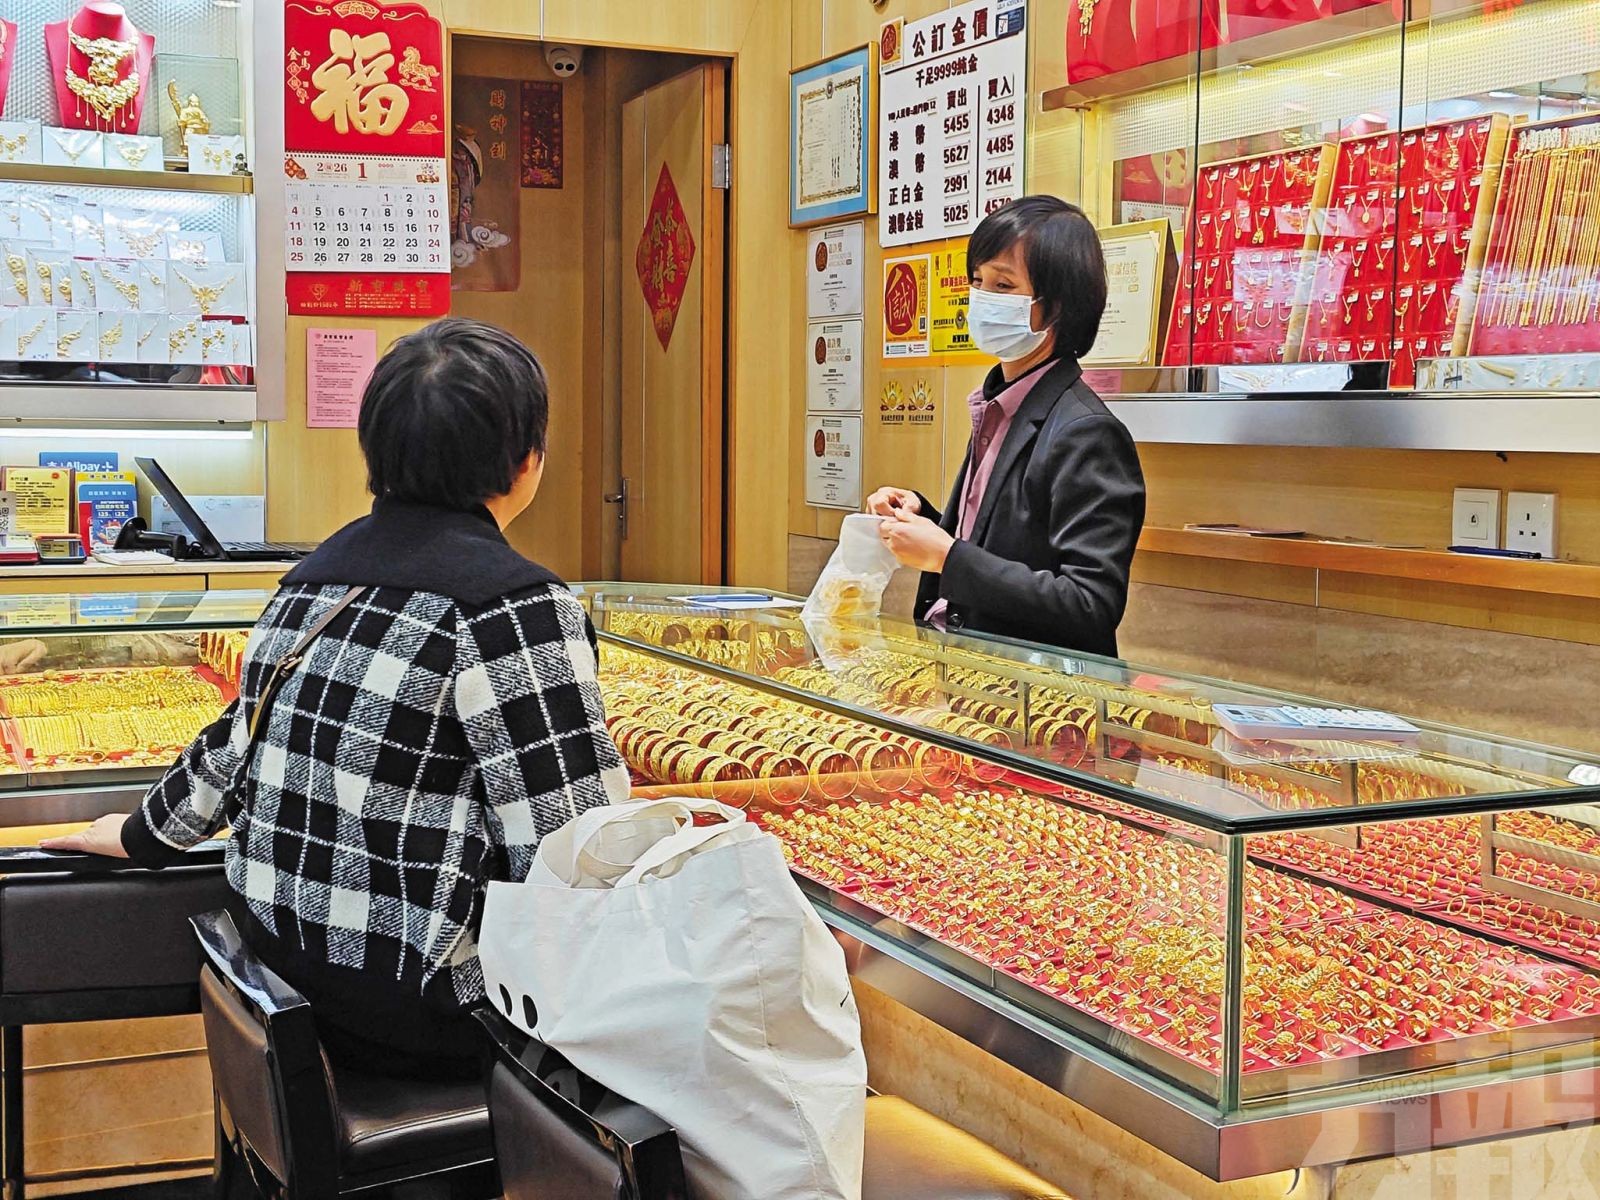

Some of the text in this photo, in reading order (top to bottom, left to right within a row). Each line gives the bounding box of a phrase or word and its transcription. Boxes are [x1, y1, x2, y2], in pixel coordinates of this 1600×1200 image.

[912, 7, 988, 57] 公訂金價
[310, 28, 410, 136] 福
[915, 53, 978, 88] 千足9999純金
[946, 76, 1012, 110] 賣出 買入
[943, 113, 969, 134] 5455
[986, 104, 1014, 125] 4348
[943, 145, 969, 164] 5627
[986, 134, 1014, 155] 4485
[357, 162, 368, 179] 1
[384, 193, 435, 203] 1 2 3
[888, 166, 1012, 206] 正白金 2991 2144
[292, 206, 439, 218] 4 5 6 7 8 9 10
[943, 204, 968, 223] 5025
[290, 222, 439, 233] 11 12 13 14 15 16 17
[290, 237, 440, 248] 18 19 20 21 22 23 24
[290, 252, 440, 263] 25 26 27 28 29 30 31
